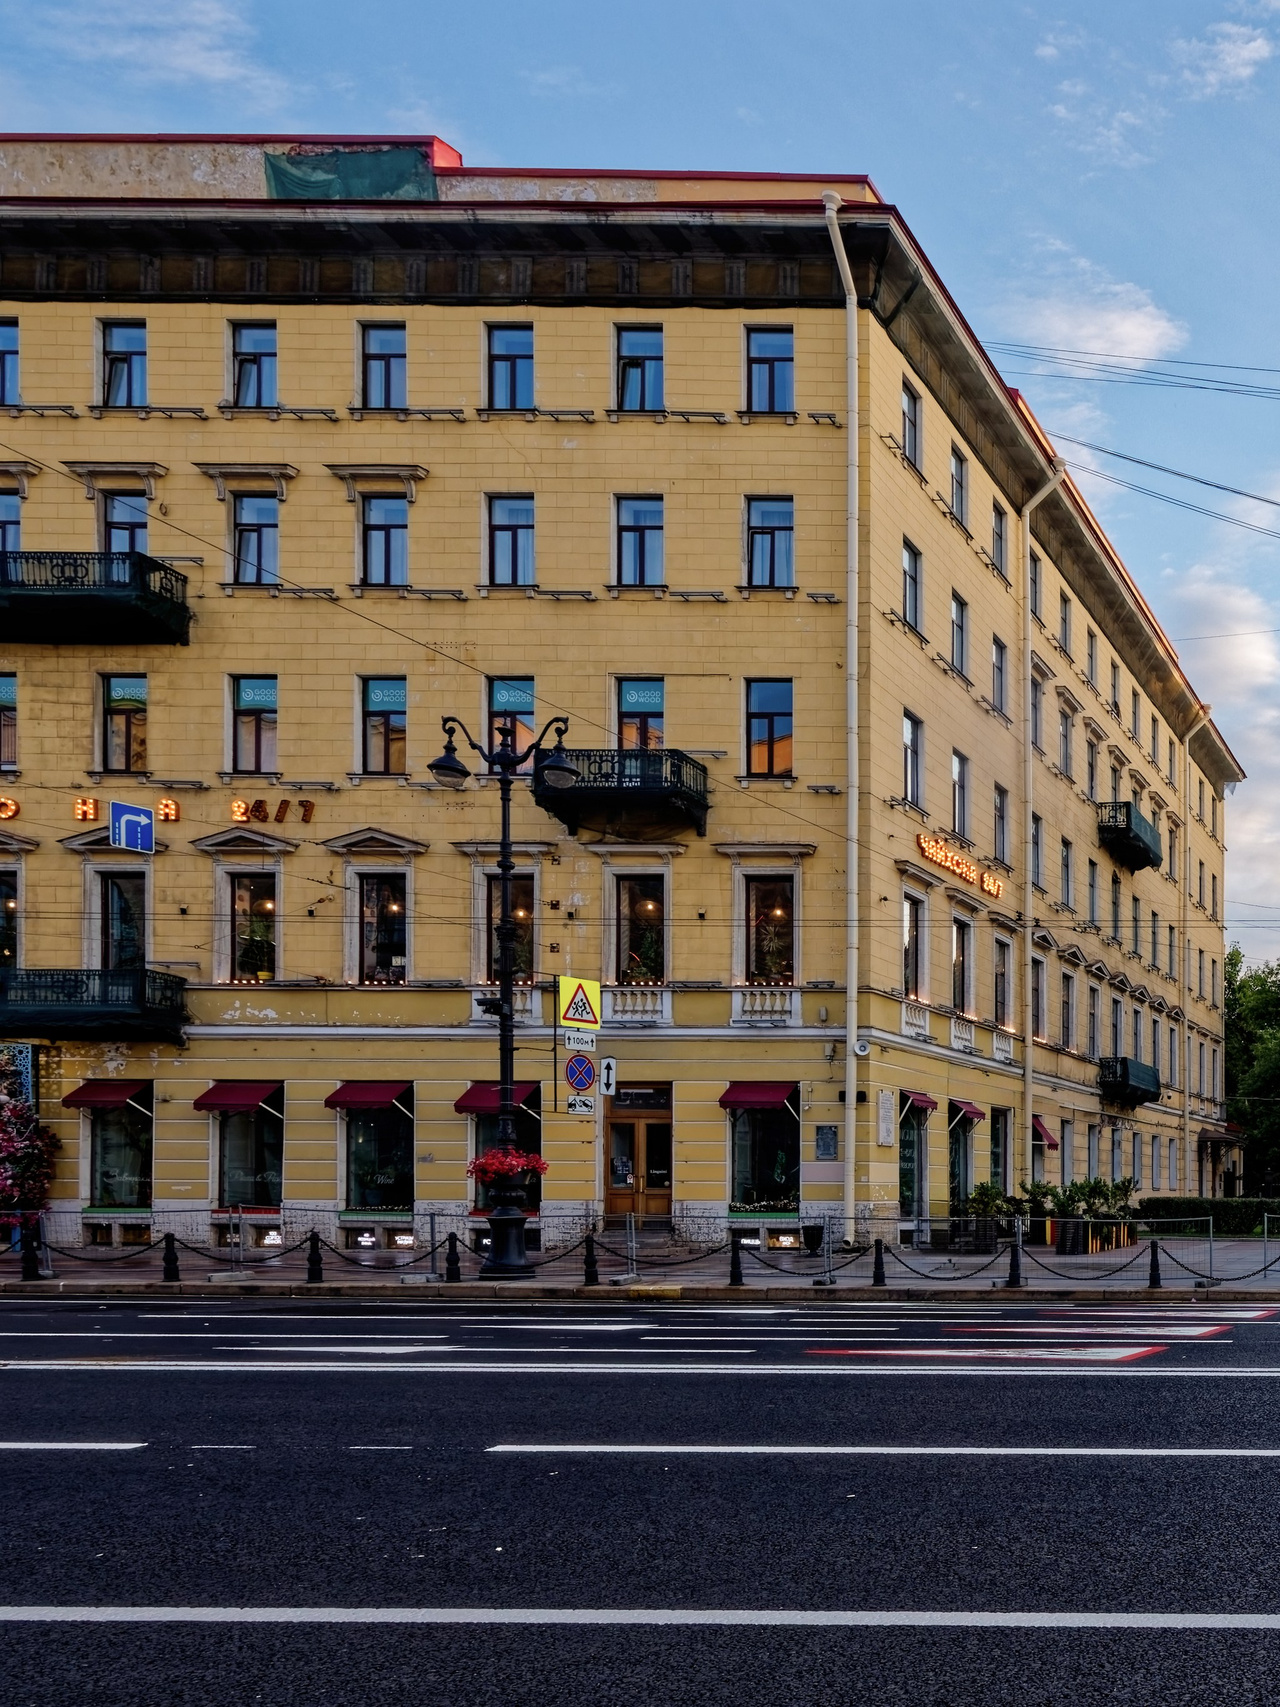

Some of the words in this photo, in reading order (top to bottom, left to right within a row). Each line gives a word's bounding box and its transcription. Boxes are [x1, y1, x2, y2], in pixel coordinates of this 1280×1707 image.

[231, 800, 315, 823] 24/7
[916, 833, 977, 885] ЧАЙХОНА
[980, 871, 1003, 899] 24/7
[572, 1037, 590, 1046] 100м
[373, 1174, 395, 1184] Wine
